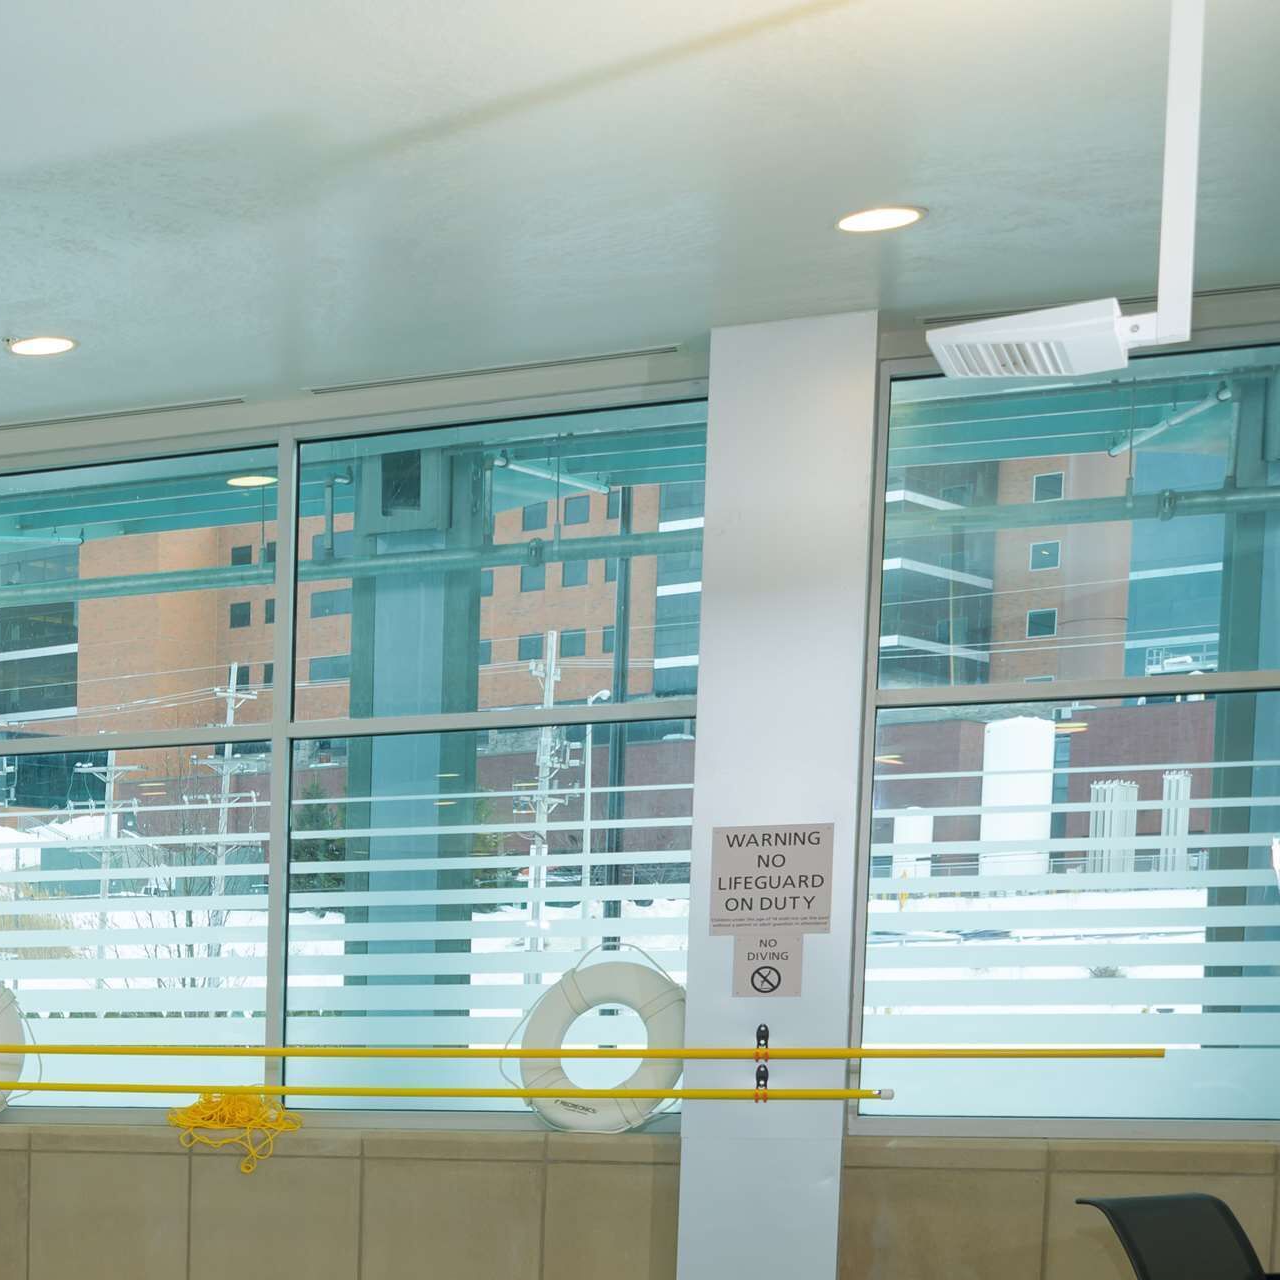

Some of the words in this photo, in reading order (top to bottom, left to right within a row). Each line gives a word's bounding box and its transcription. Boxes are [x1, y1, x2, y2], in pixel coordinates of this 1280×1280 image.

[726, 831, 821, 848] WARNING
[757, 853, 786, 868] NO
[718, 874, 824, 891] LIFEGUARD
[725, 897, 753, 912] ON
[760, 896, 815, 911] DUTY
[759, 939, 777, 948] NO
[747, 951, 789, 961] DIVING
